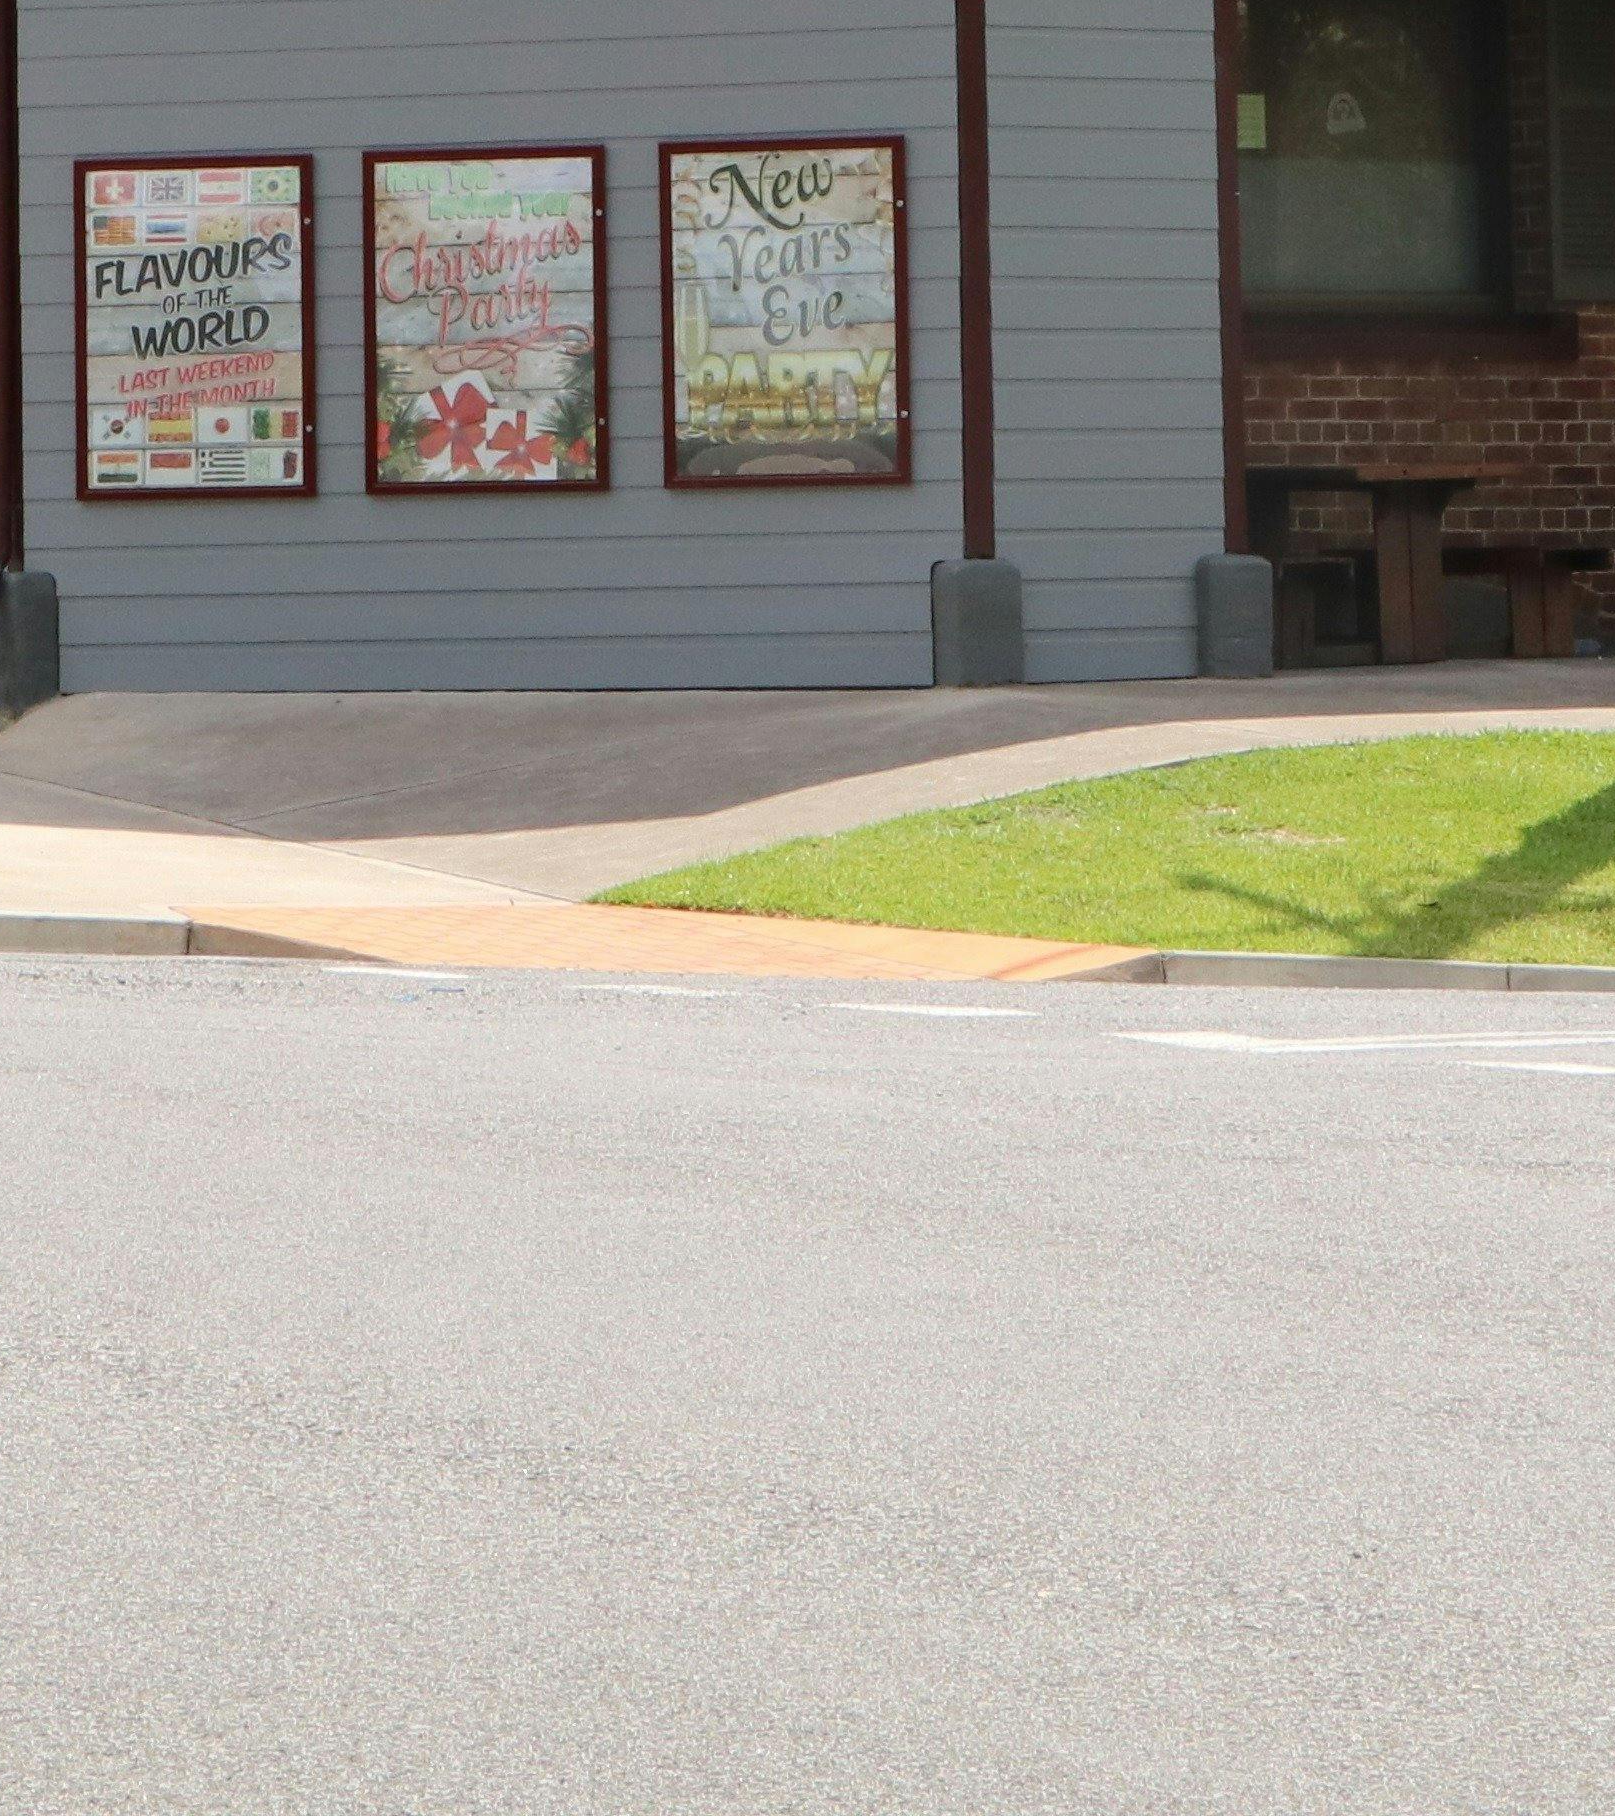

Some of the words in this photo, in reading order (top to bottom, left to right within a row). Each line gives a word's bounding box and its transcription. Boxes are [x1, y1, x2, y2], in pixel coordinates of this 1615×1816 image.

[704, 153, 834, 230] New
[94, 233, 292, 299] FLAVOURS
[379, 220, 582, 304] Christmas
[718, 222, 851, 292] Years
[131, 305, 270, 361] WORLD
[161, 294, 186, 315] OF
[194, 285, 233, 308] THE
[427, 266, 568, 350] Party
[762, 284, 845, 346] Eve
[118, 366, 169, 394] LAST
[176, 352, 275, 386] WEEKEND
[126, 401, 148, 419] IN
[149, 393, 194, 416] THE
[198, 378, 276, 407] MONTH
[688, 348, 896, 427] PARTY
